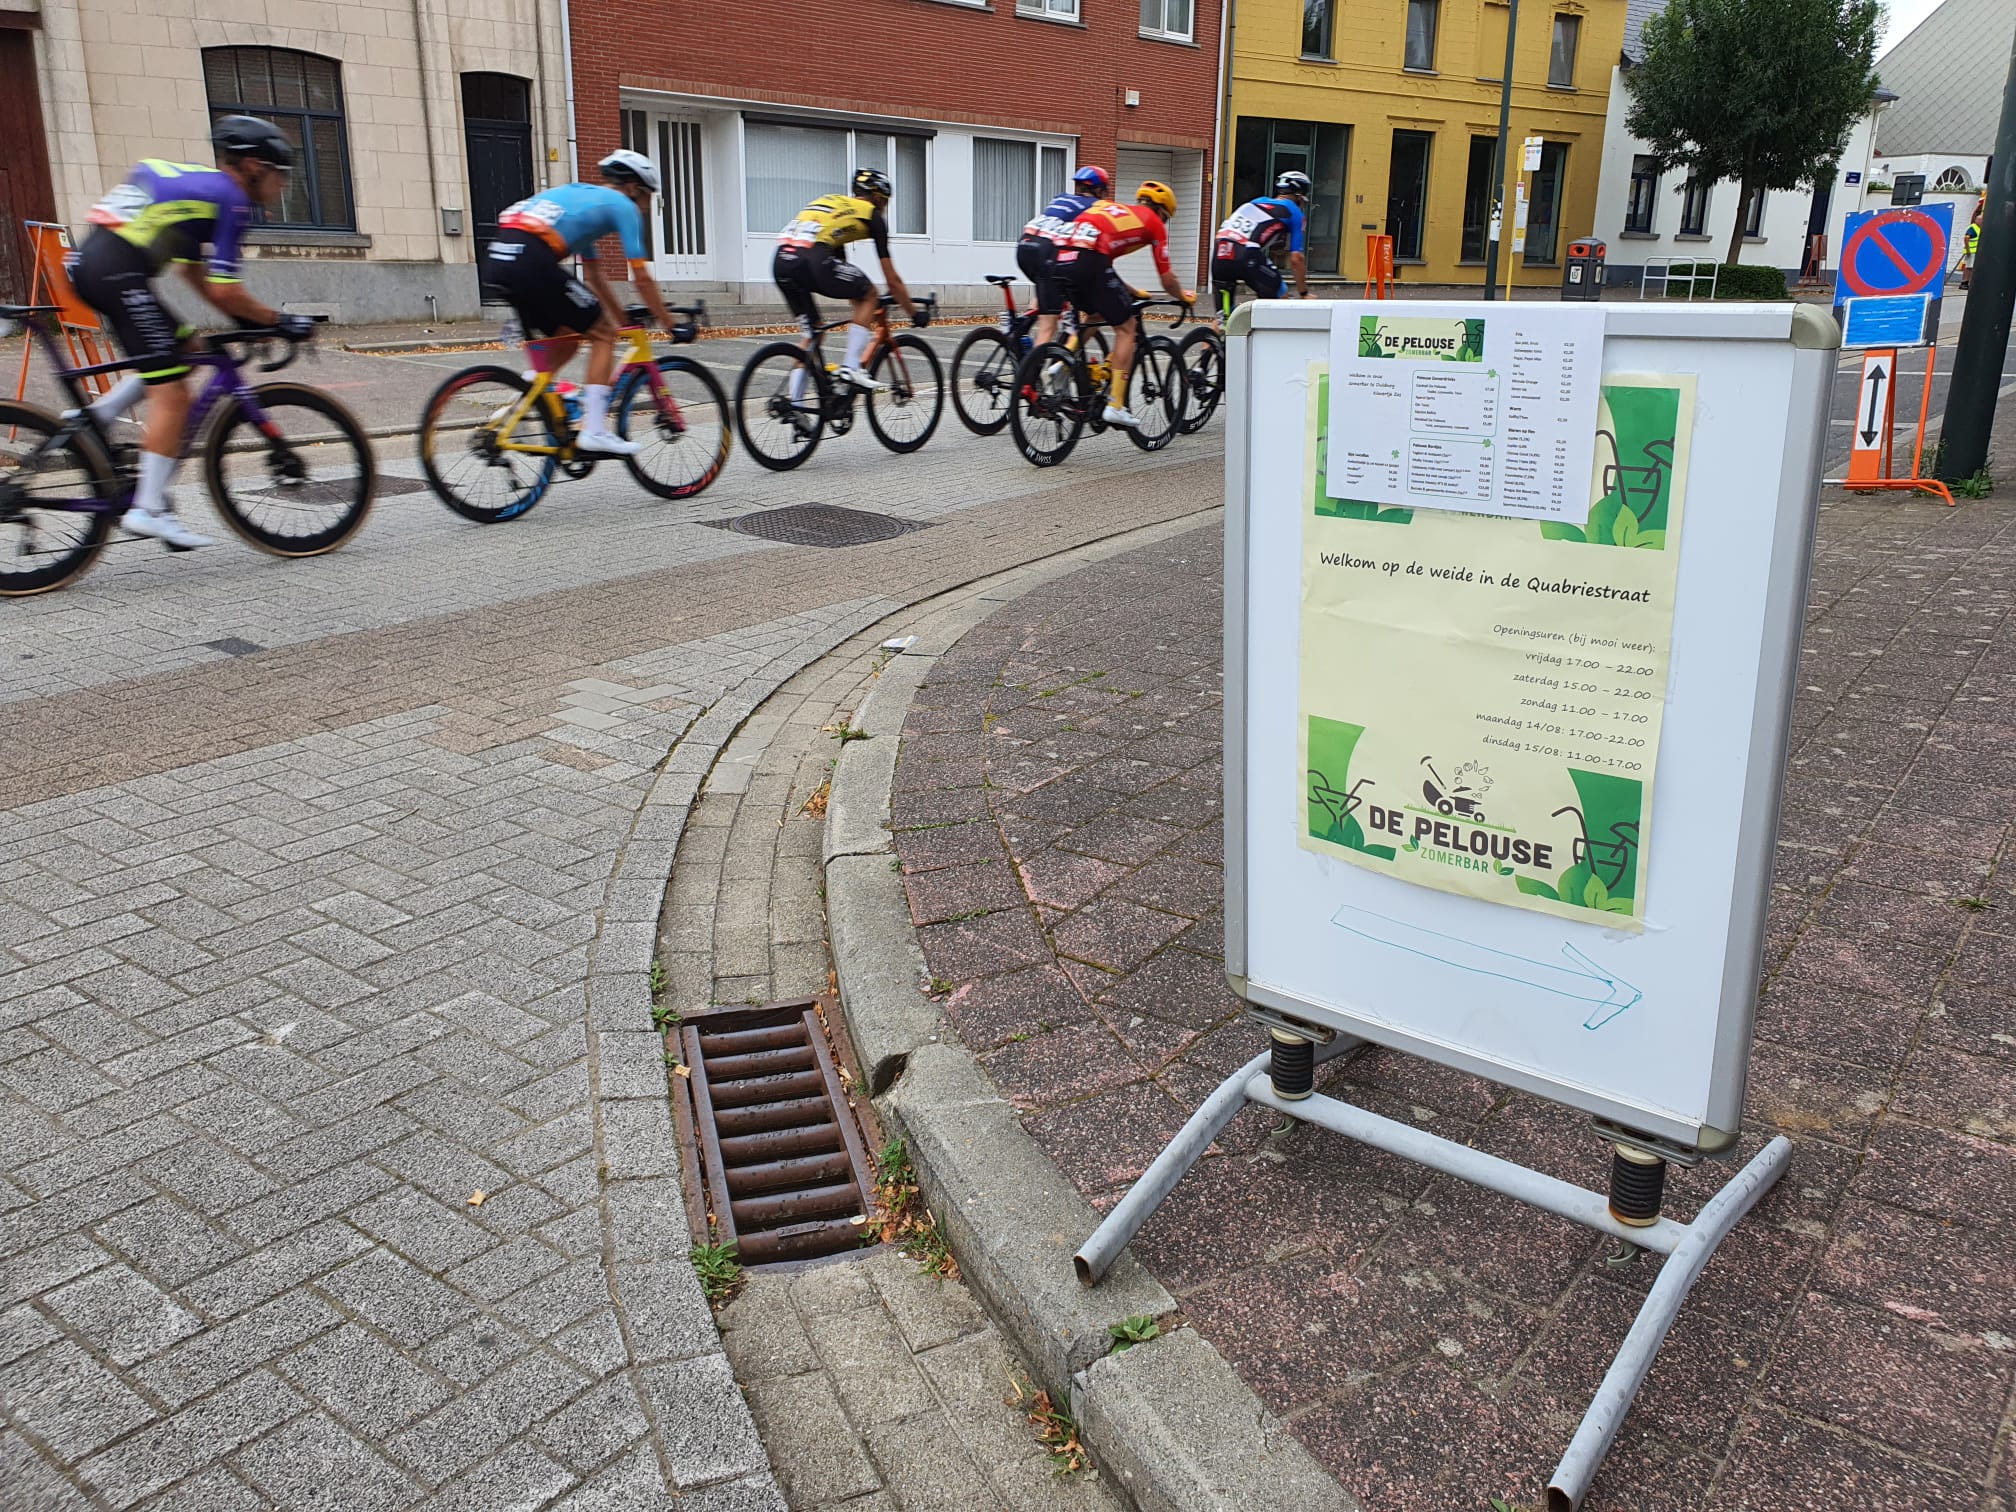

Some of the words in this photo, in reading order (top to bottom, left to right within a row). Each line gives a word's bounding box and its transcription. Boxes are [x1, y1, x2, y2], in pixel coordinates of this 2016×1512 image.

[1385, 336, 1400, 347] DE
[1403, 337, 1456, 350] PELOUSE
[1035, 453, 1052, 464] SWISS
[1320, 552, 1376, 570] Welkom
[1382, 561, 1400, 576] op
[1406, 560, 1424, 576] de
[1430, 566, 1473, 582] weide
[1479, 570, 1494, 584] in
[1500, 573, 1520, 588] de
[1527, 577, 1651, 603] Quabriestraat
[1493, 624, 1565, 641] Openingsuren
[1568, 633, 1587, 647] (bij
[1590, 637, 1618, 648] mooi
[1621, 642, 1656, 654] weer):
[1526, 652, 1562, 667] vrijdag
[1566, 657, 1600, 669] 17.00
[1616, 664, 1654, 676] 22.00
[1513, 673, 1559, 689] zaterdag
[1563, 681, 1597, 693] 15.00
[1614, 688, 1651, 700] 22.00
[1520, 697, 1558, 712] zondag
[1561, 704, 1596, 716] 11.00
[1613, 712, 1648, 724] 17.00
[1476, 712, 1522, 729] maandag
[1526, 721, 1565, 735] 14/08:
[1568, 728, 1645, 747] 17.00-22.00
[1482, 734, 1521, 752] dinsdag
[1524, 743, 1563, 757] 15/08:
[1567, 751, 1642, 771] 11.00-17.00
[1369, 805, 1404, 836] DE
[1414, 816, 1553, 870] PELOUSE
[1420, 847, 1489, 873] ZOMERBAR
